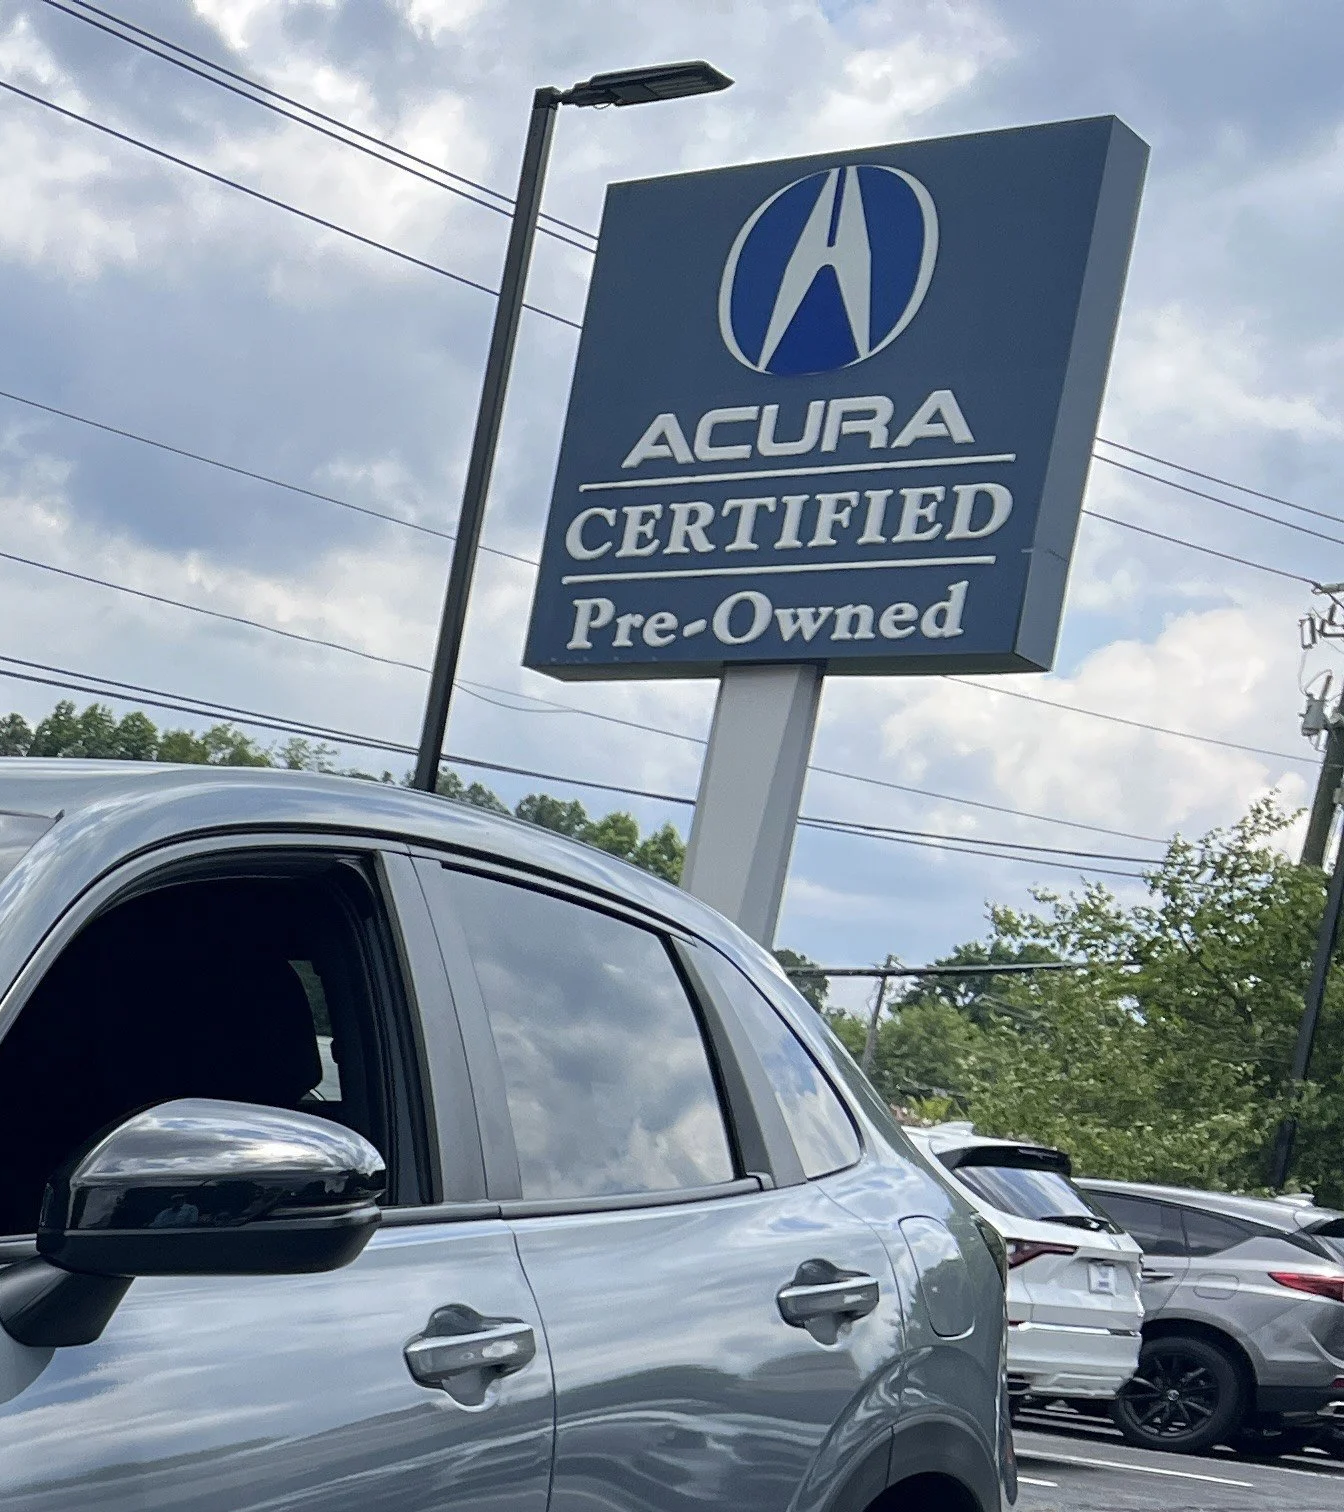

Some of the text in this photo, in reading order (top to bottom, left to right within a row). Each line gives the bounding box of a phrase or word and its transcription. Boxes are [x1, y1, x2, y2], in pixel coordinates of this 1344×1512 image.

[620, 389, 976, 469] ACURA
[564, 482, 1014, 561] CERTIFIED
[566, 580, 970, 651] Pre-Owned
